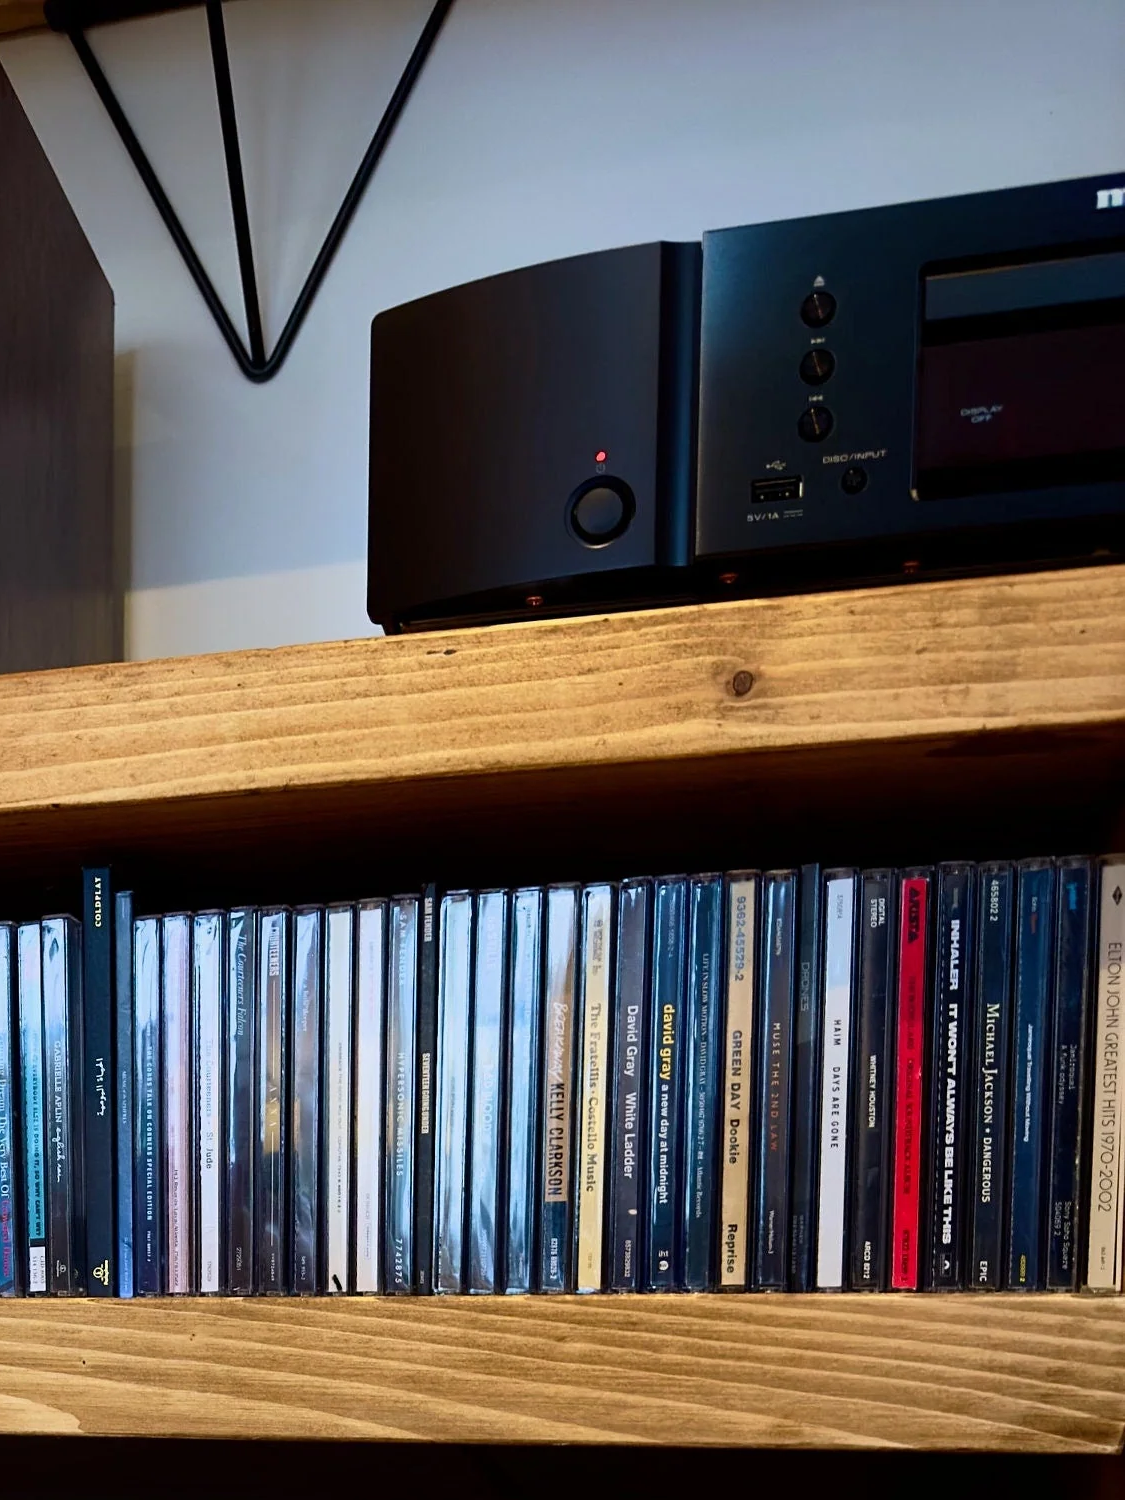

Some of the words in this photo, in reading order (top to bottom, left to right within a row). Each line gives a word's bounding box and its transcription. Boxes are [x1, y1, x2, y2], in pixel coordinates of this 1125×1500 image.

[823, 450, 887, 464] DISC/INPUT
[747, 512, 779, 522] 5V/1A
[94, 877, 102, 928] COLDPLAY
[424, 897, 433, 913] SAM
[989, 880, 999, 914] 465802
[238, 934, 247, 951] The
[424, 914, 433, 942] FENDER
[734, 896, 747, 981] 9362-45529-2
[950, 919, 960, 990] INHALER
[1107, 942, 1122, 985] ELTON
[237, 953, 247, 1005] Courteeners
[801, 962, 810, 1012] DRONES
[237, 1008, 246, 1036] Falcon
[590, 1003, 601, 1028] The
[626, 1005, 638, 1042] David
[662, 1004, 675, 1045] david
[949, 1003, 958, 1019] IT
[1106, 991, 1120, 1028] JOHN
[833, 1020, 841, 1046] HAIM
[947, 1021, 958, 1075] WON'T
[986, 1003, 1000, 1065] MICHAEL
[422, 1053, 431, 1090] SEVENTEEN
[589, 1032, 600, 1088] Fratellis
[624, 1046, 637, 1077] Gray
[660, 1047, 673, 1080] gray
[732, 1030, 742, 1076] GREEN
[1103, 1032, 1118, 1093] GREATEST
[661, 1084, 668, 1092] a
[731, 1083, 741, 1110] DAY
[832, 1067, 840, 1092] DAYS
[982, 1068, 998, 1123] JACKSON
[421, 1090, 430, 1111] GOING
[550, 1083, 565, 1120] KELLY
[624, 1092, 636, 1130] White
[945, 1078, 955, 1145] ALWAYS
[1101, 1099, 1116, 1126] HITS
[421, 1111, 430, 1134] UNDER
[588, 1097, 599, 1150] Costello
[658, 1119, 669, 1139] day
[831, 1121, 839, 1148] GONE
[624, 1133, 636, 1178] Ladder
[660, 1141, 668, 1153] at
[729, 1119, 740, 1164] Dookie
[945, 1146, 954, 1168] BE
[548, 1128, 564, 1195] CLARKSON
[586, 1153, 597, 1192] Music
[657, 1155, 669, 1204] midnight
[981, 1137, 992, 1203] DANGEROUS
[1098, 1132, 1114, 1212] 1970-2002
[944, 1170, 953, 1204] LIKE
[942, 1207, 952, 1244] THIS
[725, 1224, 737, 1273] Reprise
[979, 1261, 988, 1282] EPIC
